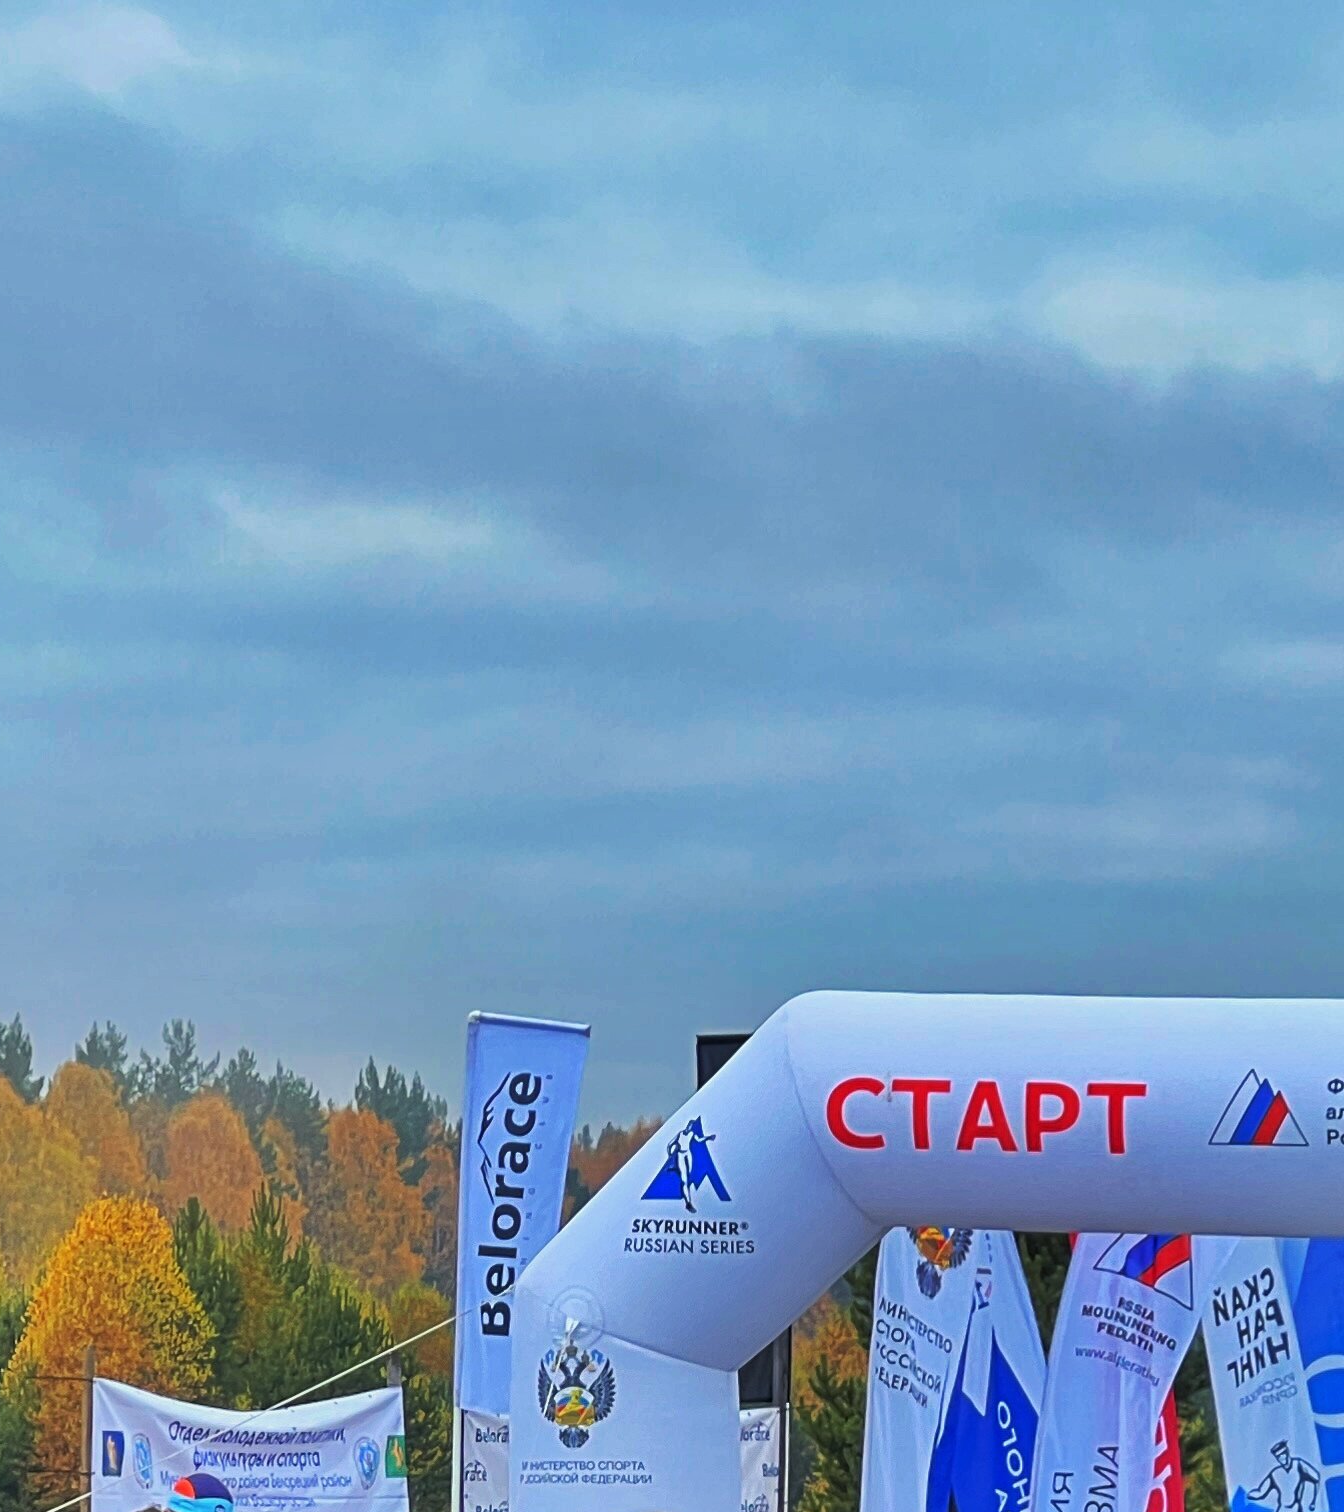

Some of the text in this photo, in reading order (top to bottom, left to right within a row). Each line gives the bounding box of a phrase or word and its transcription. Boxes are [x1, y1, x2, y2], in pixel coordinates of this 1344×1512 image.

[826, 1077, 1147, 1154] СТАРТ
[478, 1071, 543, 1337] Belorace
[624, 1238, 755, 1254] RUSSIAN SERIES
[169, 1420, 210, 1444] Отдел
[475, 1424, 510, 1444] Belora
[276, 1451, 320, 1471] спорта
[597, 1460, 646, 1471] СПОРТА
[581, 1474, 653, 1485] ФЕДЕРАЦИИ
